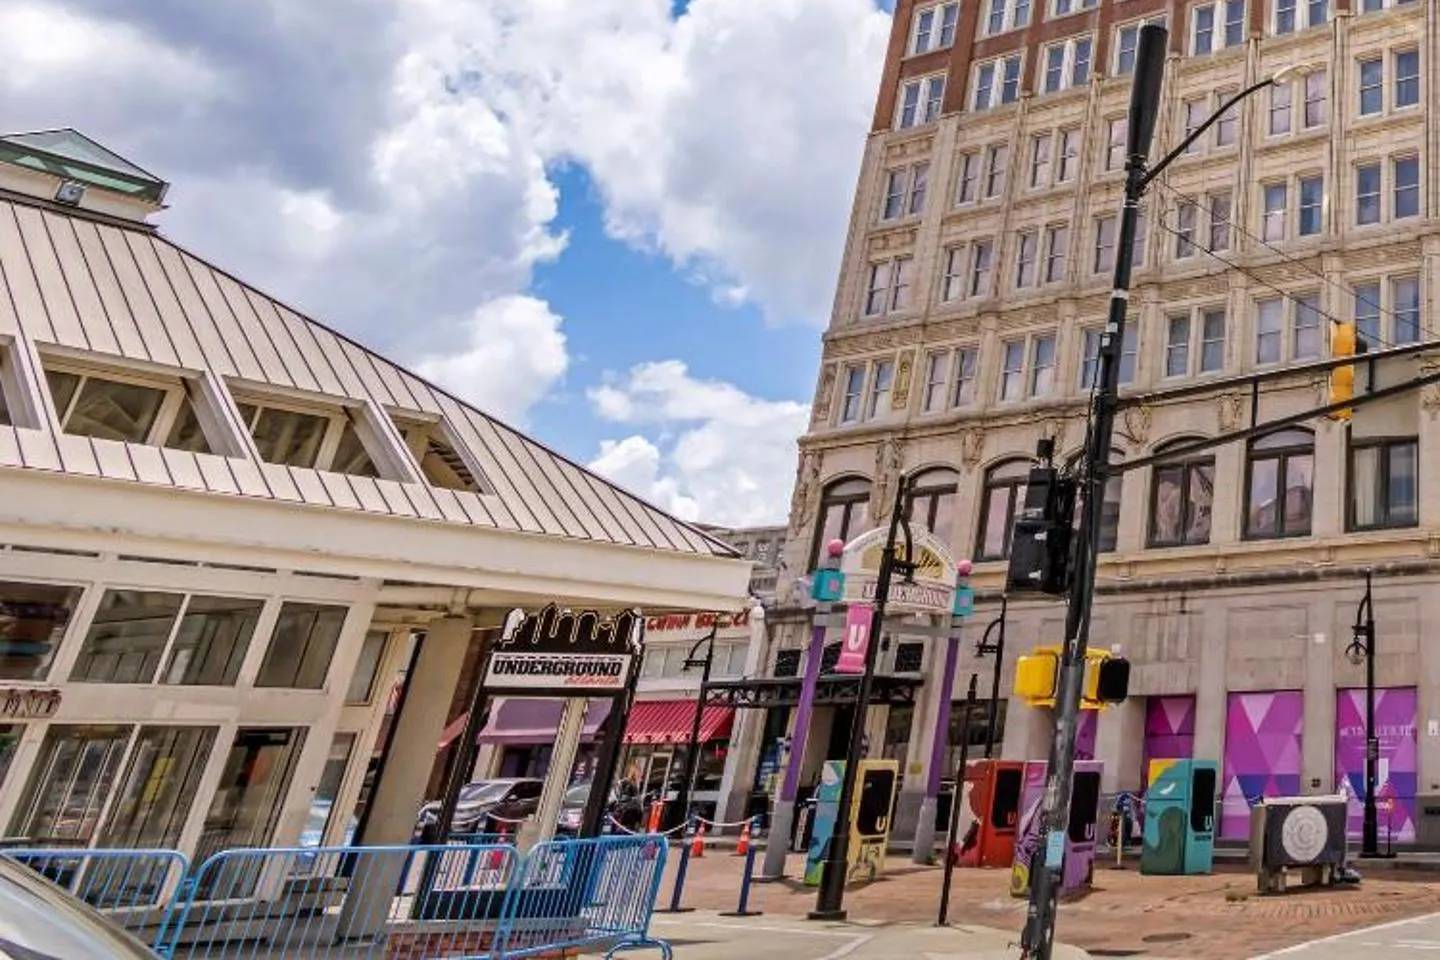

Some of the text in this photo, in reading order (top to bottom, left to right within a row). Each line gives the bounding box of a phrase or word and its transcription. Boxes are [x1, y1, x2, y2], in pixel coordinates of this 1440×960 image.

[847, 624, 865, 651] U
[492, 659, 624, 677] UNDERGROUND
[875, 815, 887, 831] U
[1204, 815, 1213, 830] U
[1084, 823, 1096, 839] U
